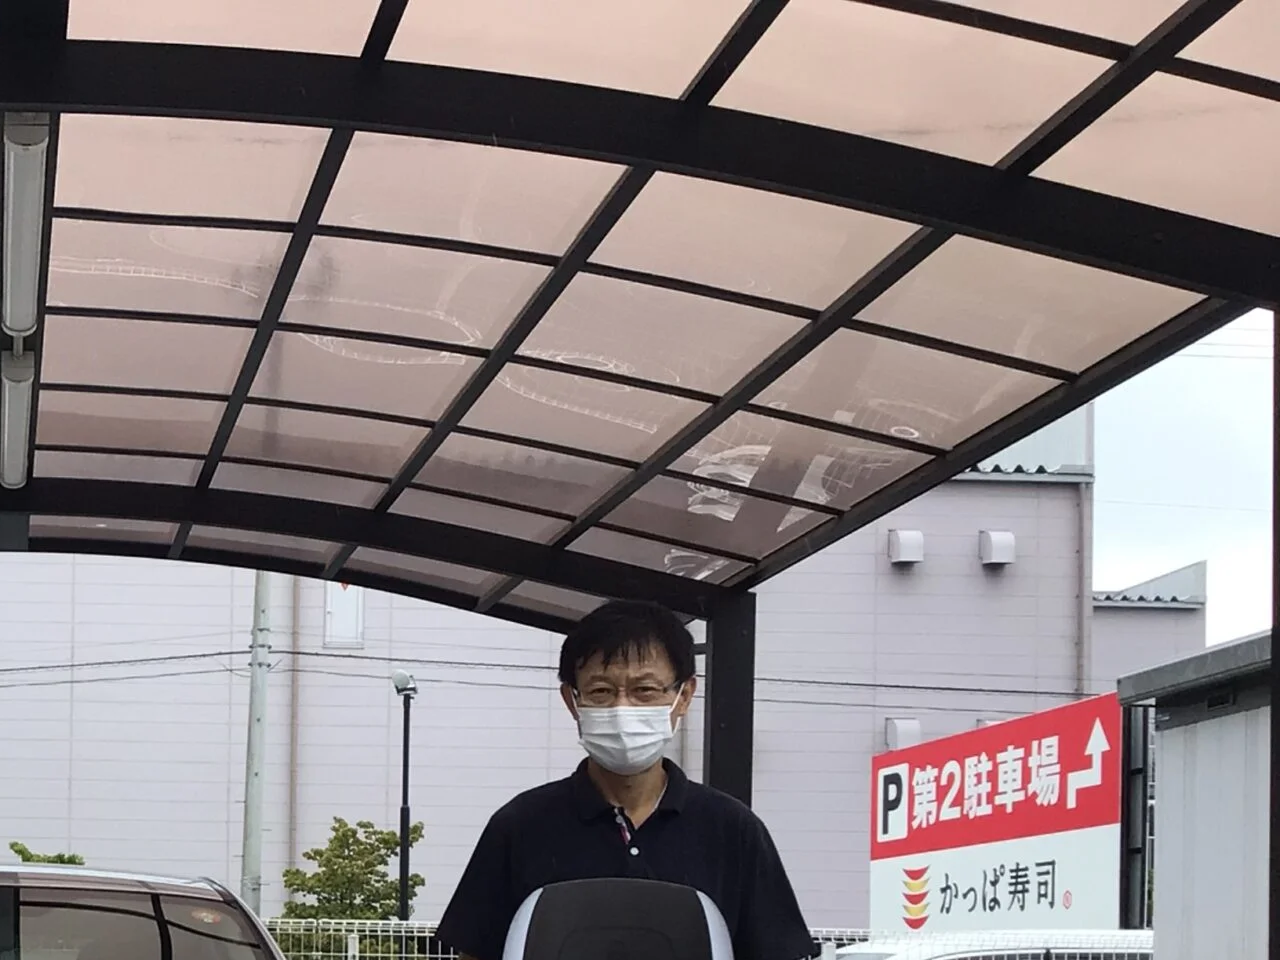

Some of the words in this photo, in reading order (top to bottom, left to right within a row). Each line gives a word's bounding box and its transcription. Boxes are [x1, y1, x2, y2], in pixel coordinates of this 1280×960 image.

[882, 772, 903, 835] P
[911, 735, 1061, 829] 第2駐車場
[939, 859, 1056, 915] かっぱ寿司
